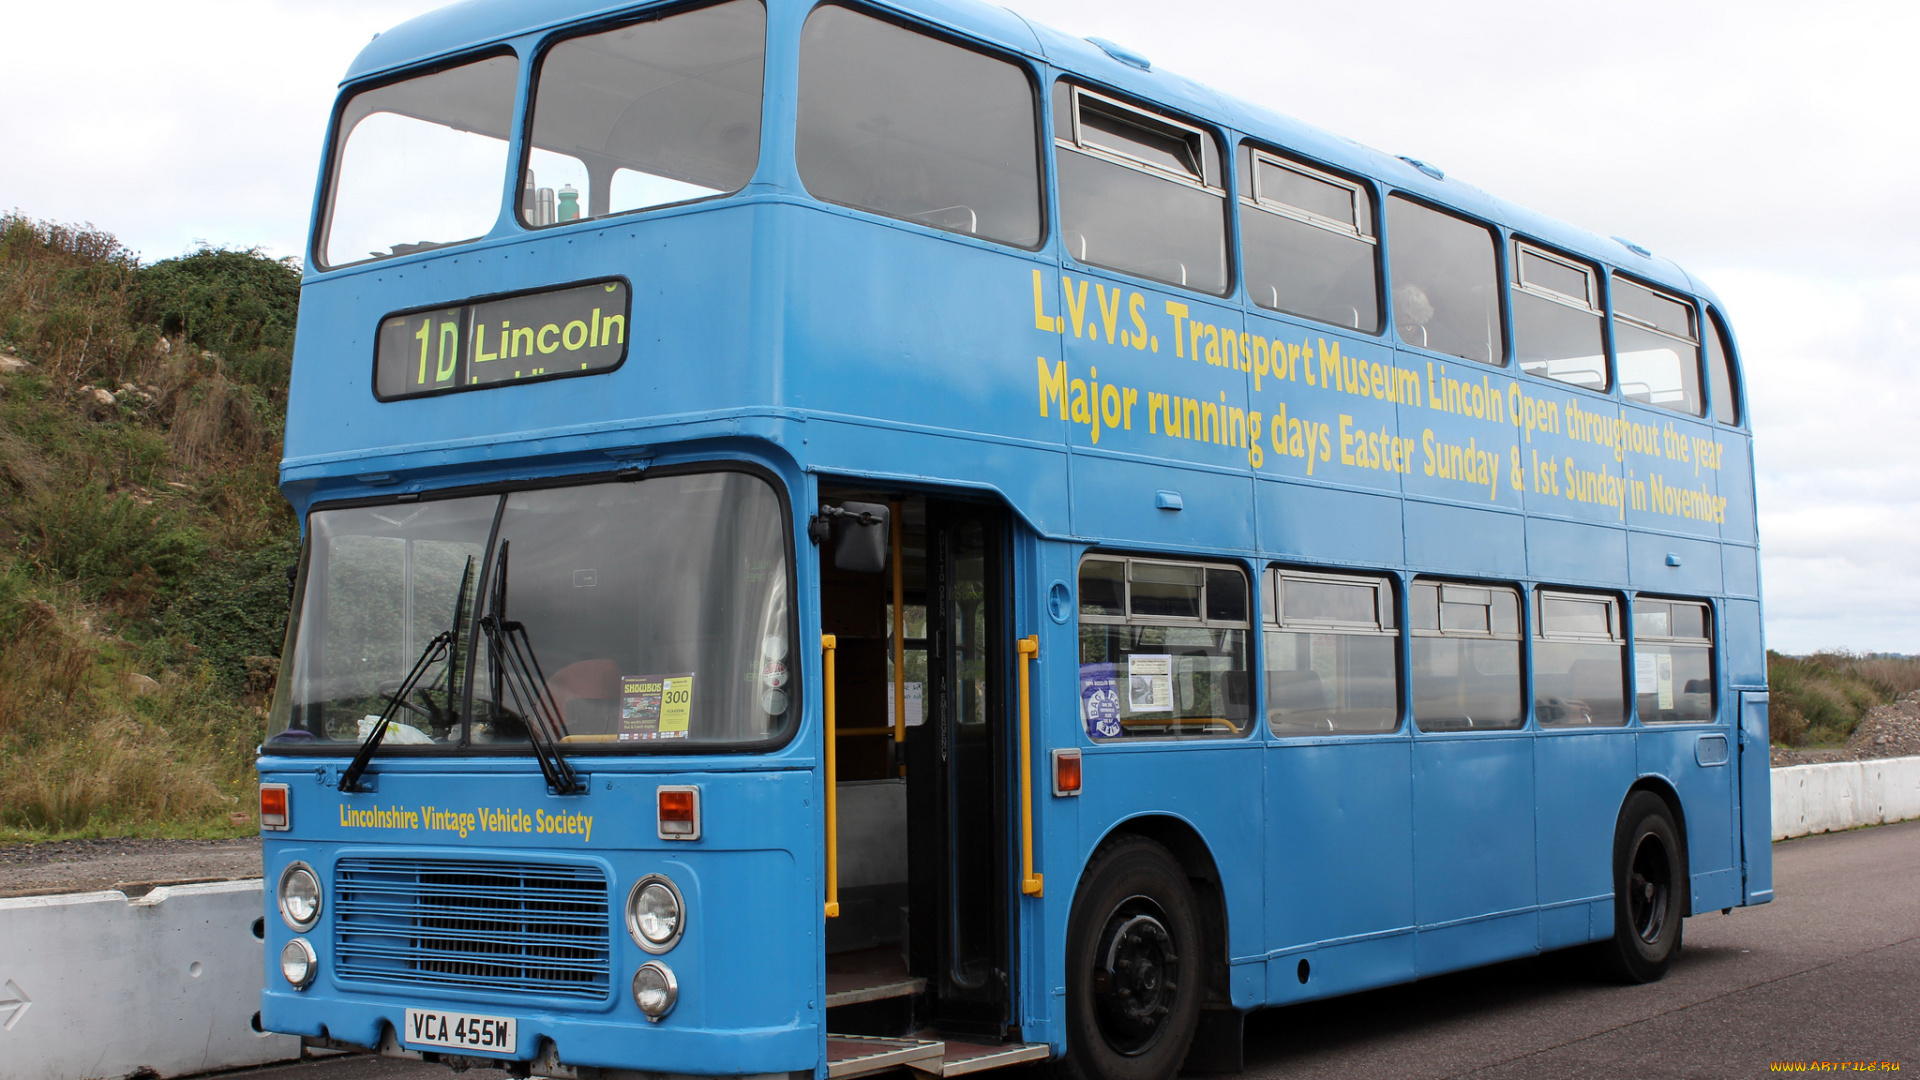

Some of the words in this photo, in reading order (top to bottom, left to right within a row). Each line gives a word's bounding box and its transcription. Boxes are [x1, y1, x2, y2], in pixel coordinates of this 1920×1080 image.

[475, 308, 625, 362] Lincoln
[1033, 269, 1158, 353] L.V.V.S.
[1166, 300, 1315, 391] Transport
[1318, 338, 1421, 407] Museum
[1427, 362, 1503, 423] Lincoln
[1508, 382, 1560, 443] Open
[1565, 398, 1661, 462] throughout
[1663, 421, 1689, 463] the
[1691, 436, 1723, 477] year
[1037, 356, 1138, 445] Major
[1148, 390, 1264, 469] running
[1271, 402, 1331, 476] days
[1339, 414, 1415, 474] Easter
[1422, 428, 1499, 501] Sunday
[1511, 445, 1526, 491] &
[1565, 457, 1626, 520] Sunday
[1630, 469, 1647, 511] in
[1650, 473, 1727, 524] November
[624, 683, 662, 693] SHOWBUS
[665, 690, 689, 704] 300
[1090, 693, 1102, 717] BAG
[340, 804, 419, 830] Lincolnshire
[421, 806, 476, 838] Vintage
[478, 807, 532, 832] Vehicle
[536, 808, 593, 842] Society
[413, 1013, 448, 1041] VCA
[455, 1018, 508, 1047] 455W
